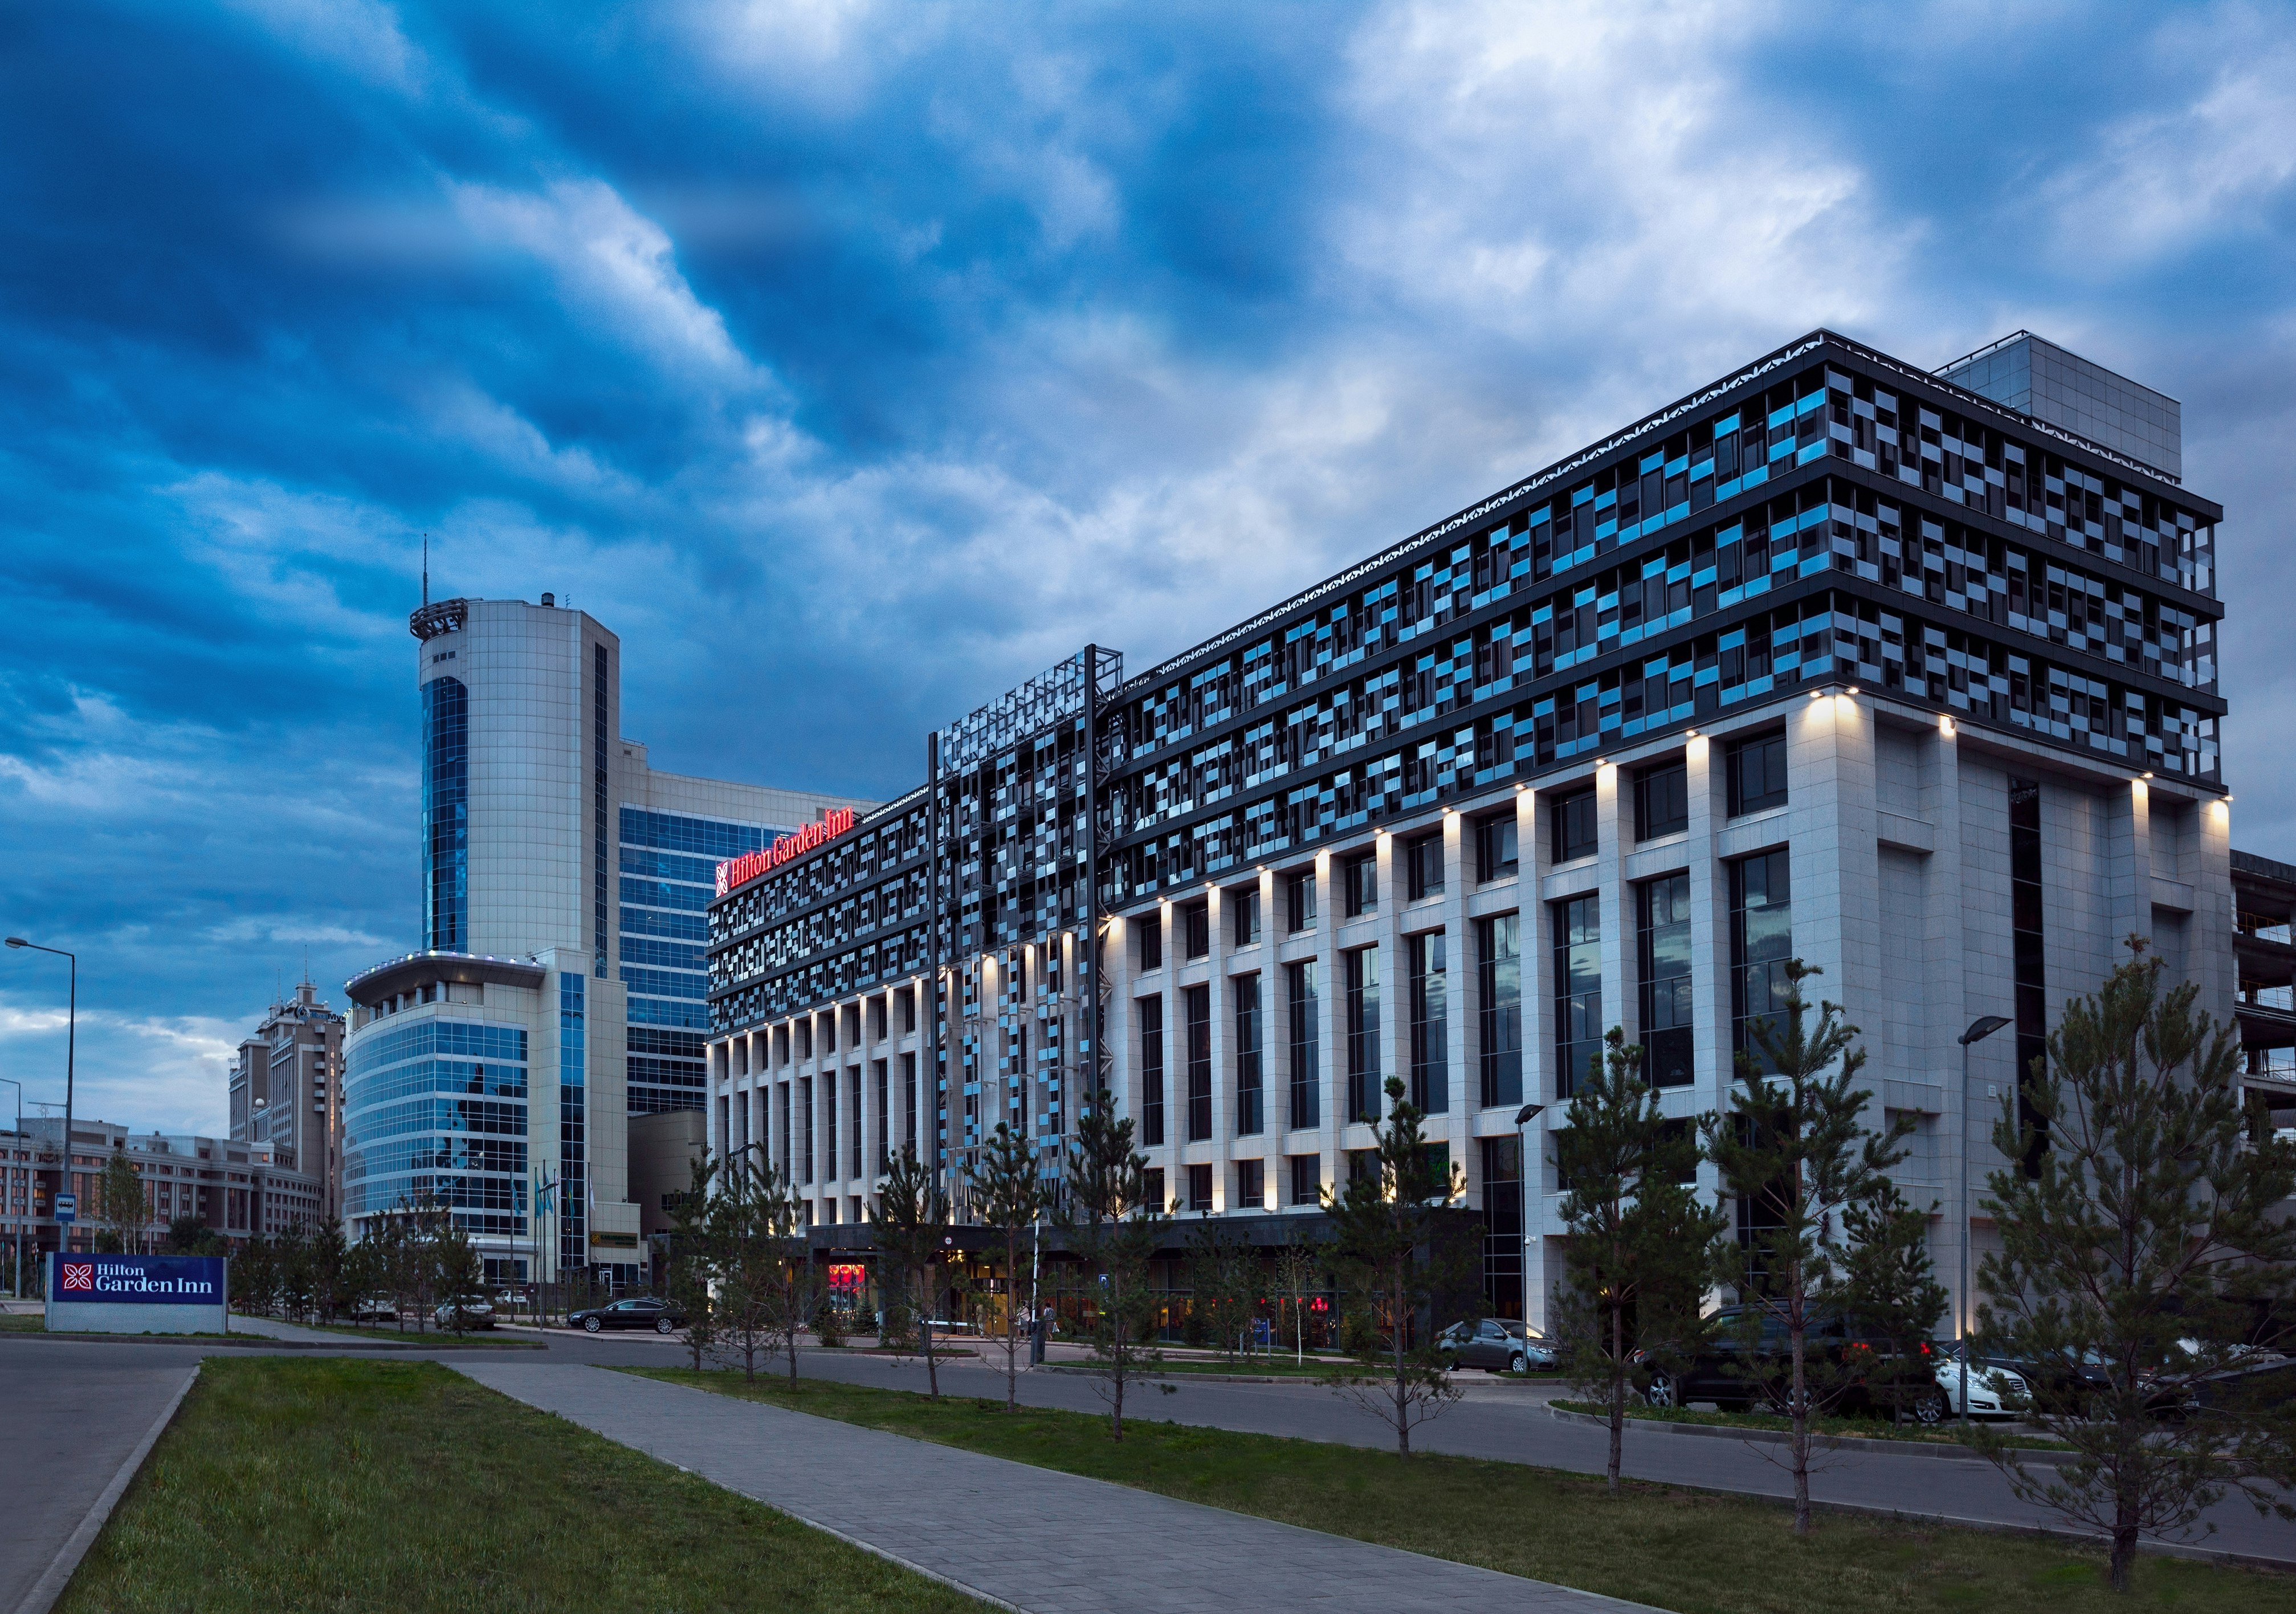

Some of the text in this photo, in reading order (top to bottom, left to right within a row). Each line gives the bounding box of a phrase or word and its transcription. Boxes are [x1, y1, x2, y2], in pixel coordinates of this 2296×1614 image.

[730, 806, 854, 888] Hilton Garden Inn
[97, 1264, 144, 1275] Hilton
[96, 1275, 213, 1293] Garden Inn
